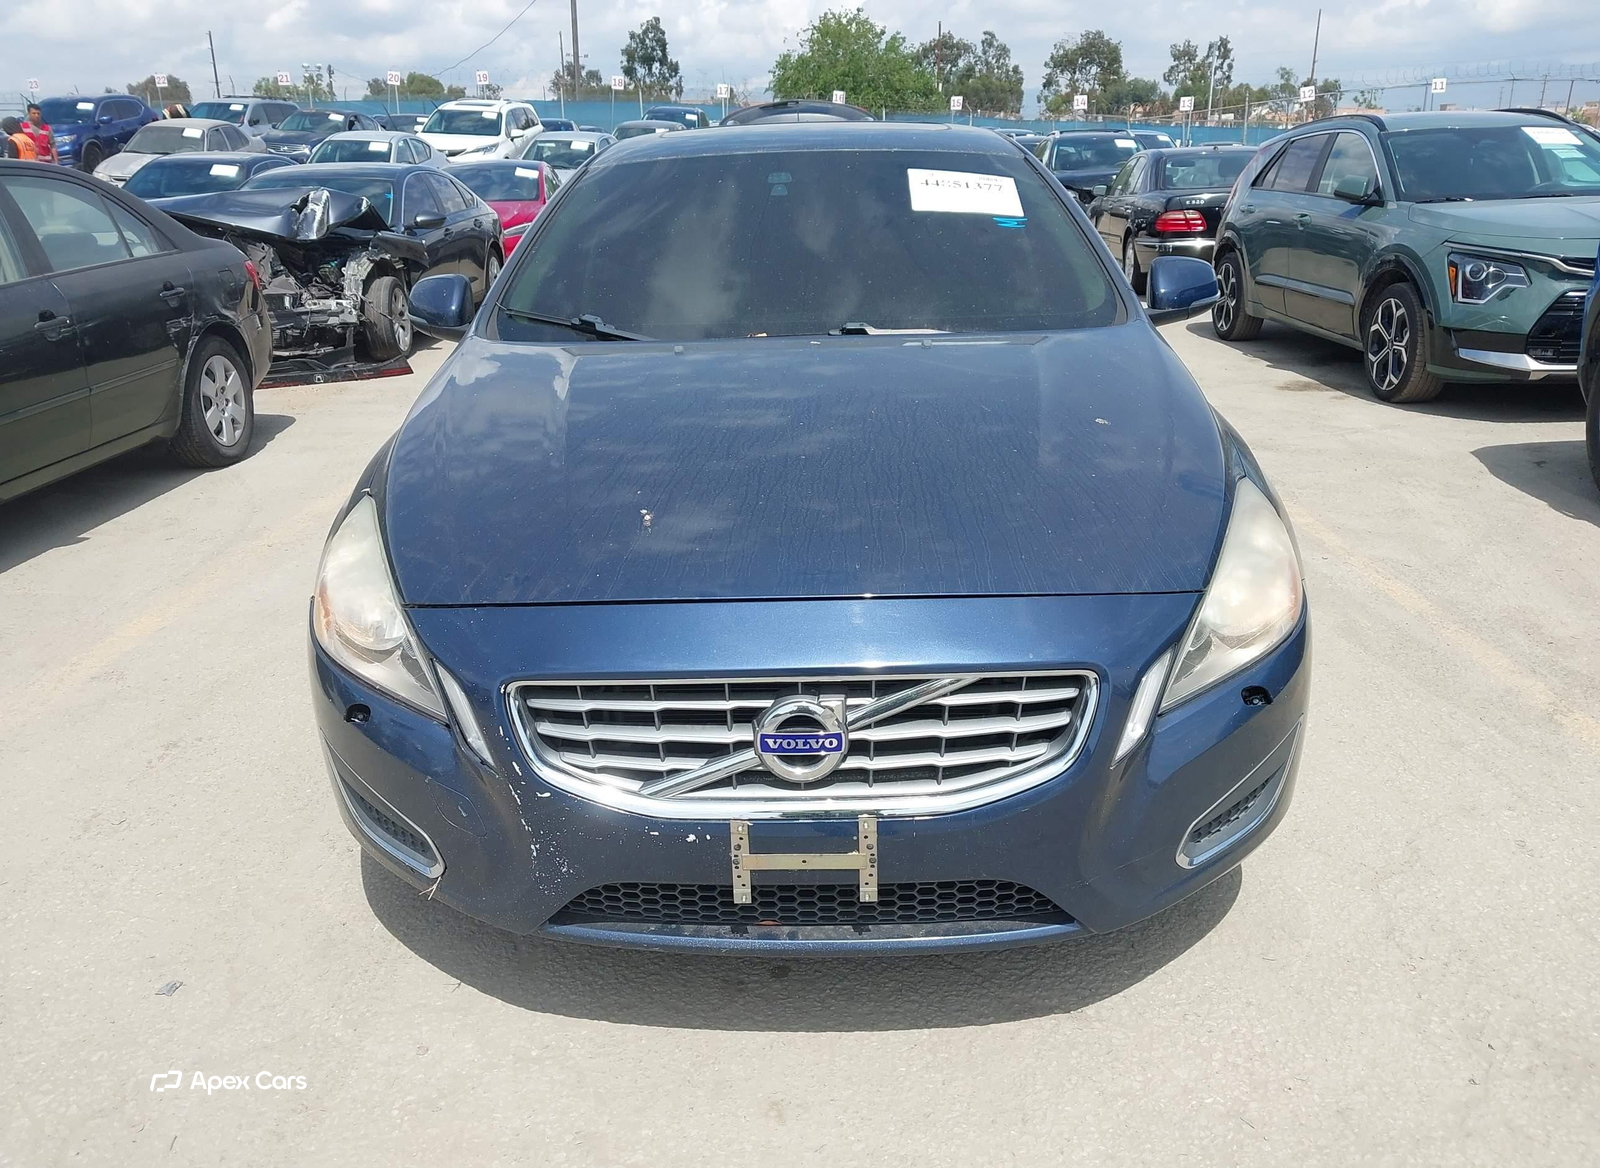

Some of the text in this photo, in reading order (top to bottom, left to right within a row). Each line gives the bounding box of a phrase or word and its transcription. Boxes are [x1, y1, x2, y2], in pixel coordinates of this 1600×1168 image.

[156, 76, 166, 85] 22
[278, 74, 290, 83] 21
[388, 73, 399, 83] 20
[477, 73, 488, 82] 19
[29, 80, 39, 89] 23
[612, 78, 623, 87] 18
[1432, 81, 1445, 90] 11
[718, 86, 729, 95] 17
[1302, 89, 1314, 99] 12
[834, 93, 844, 102] 16
[1075, 97, 1086, 106] 14
[951, 99, 962, 107] 15
[1181, 99, 1192, 108] 13
[764, 738, 838, 749] VOLVO
